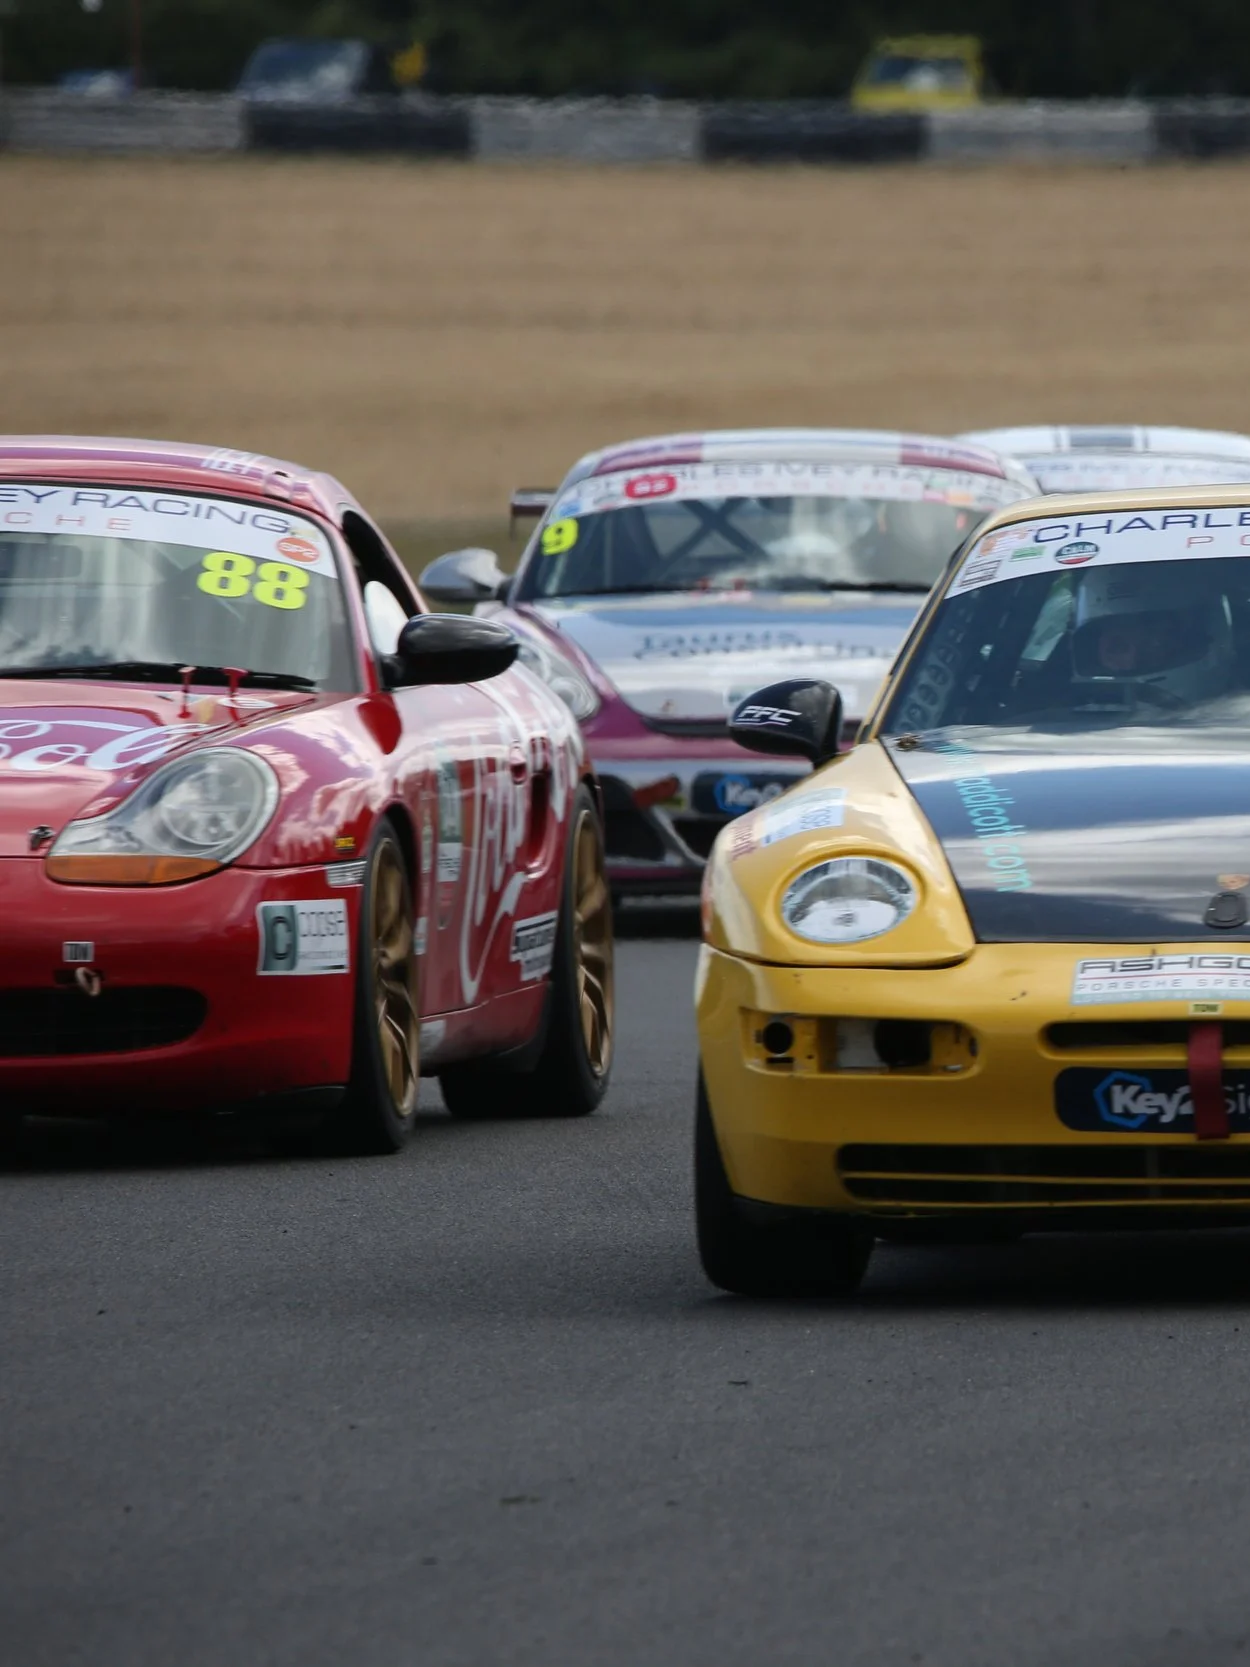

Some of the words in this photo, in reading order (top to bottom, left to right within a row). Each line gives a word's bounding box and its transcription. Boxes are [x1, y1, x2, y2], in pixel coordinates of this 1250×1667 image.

[71, 491, 290, 534] RACING
[541, 517, 580, 556] 9
[197, 552, 310, 610] 88
[1076, 978, 1183, 992] PORSCHE
[1193, 1003, 1219, 1013] TOW
